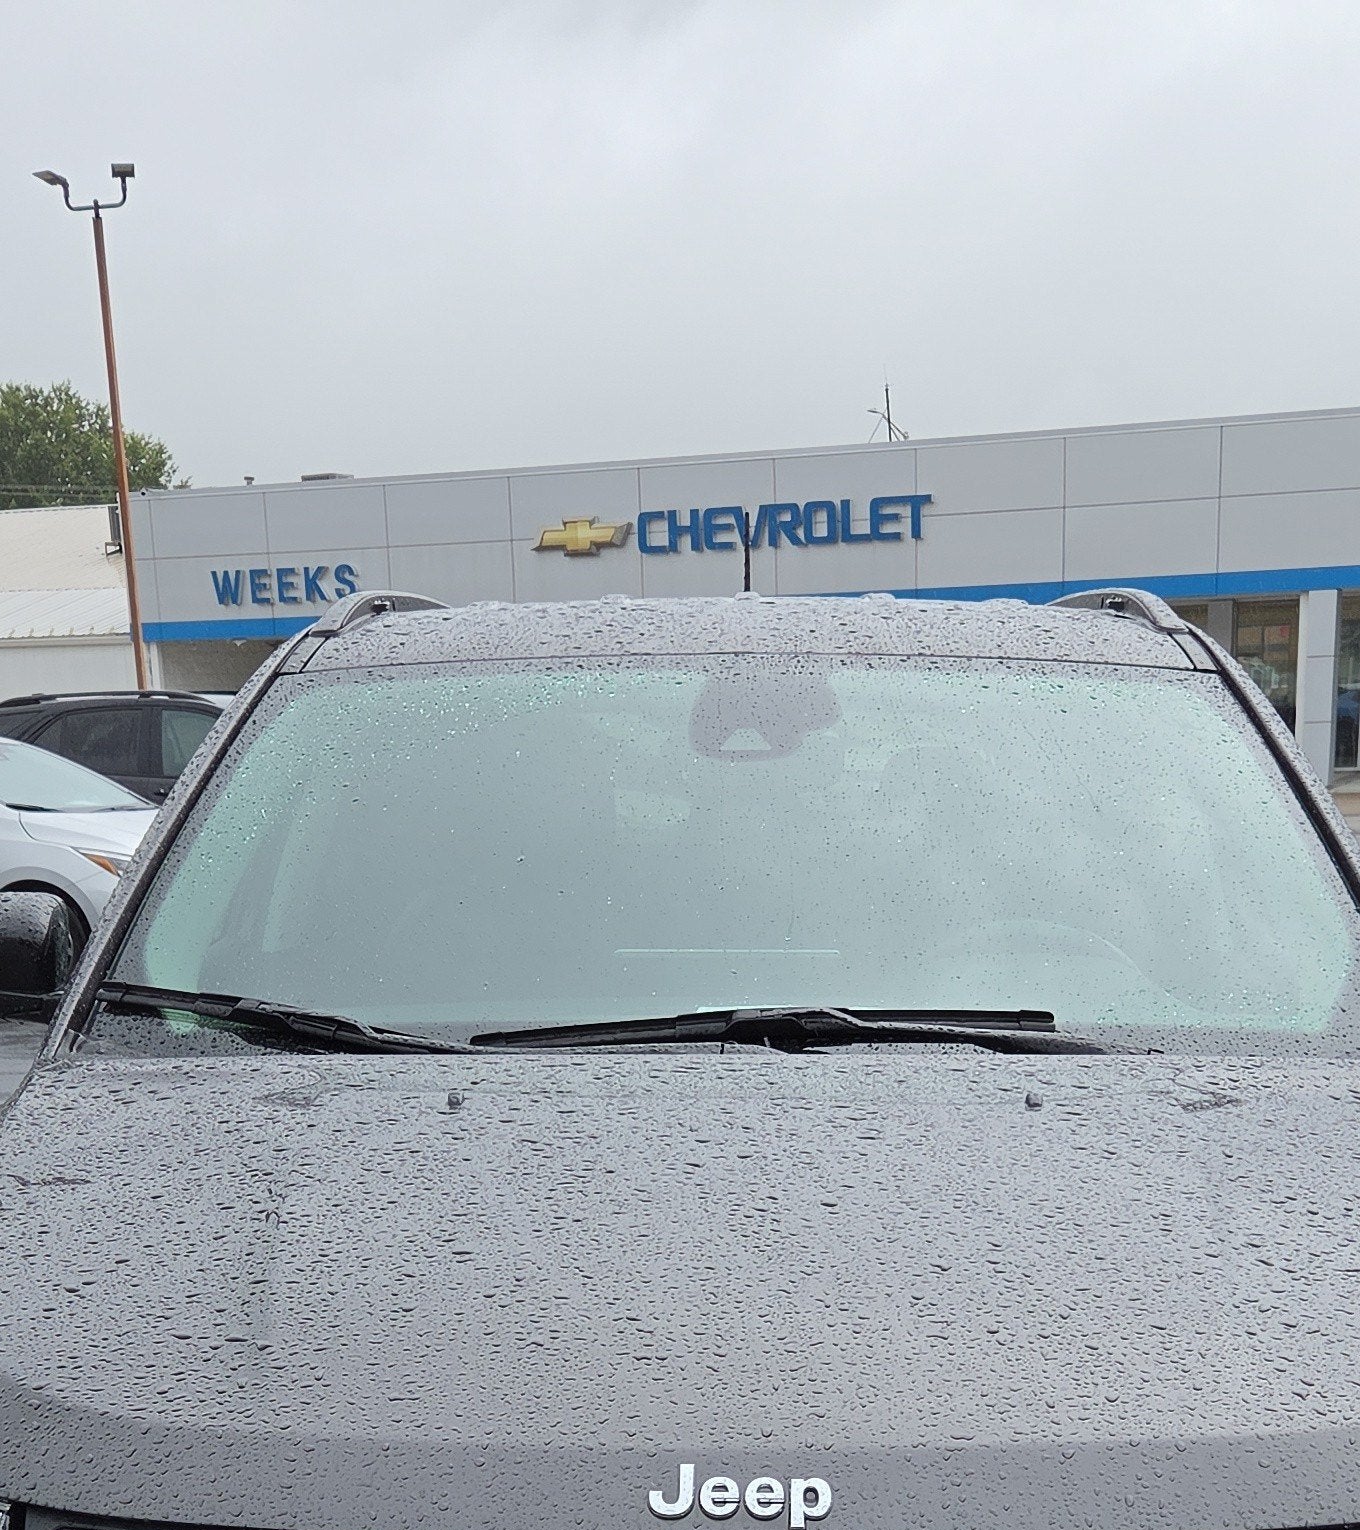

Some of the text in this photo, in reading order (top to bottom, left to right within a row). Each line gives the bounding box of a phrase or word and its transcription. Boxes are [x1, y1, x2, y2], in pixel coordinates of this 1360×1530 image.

[637, 493, 933, 555] CHEVROLET
[211, 562, 359, 606] WEEKS
[647, 1463, 832, 1530] Jeep
